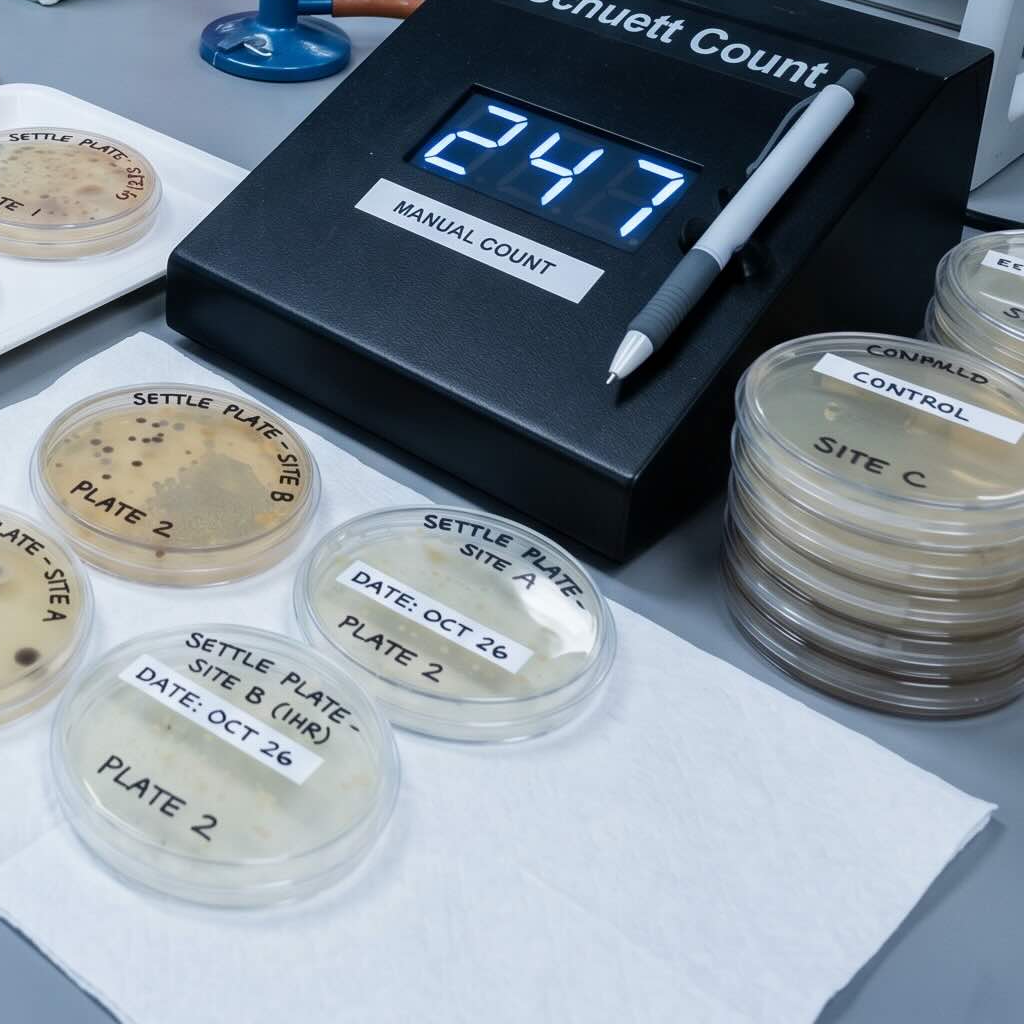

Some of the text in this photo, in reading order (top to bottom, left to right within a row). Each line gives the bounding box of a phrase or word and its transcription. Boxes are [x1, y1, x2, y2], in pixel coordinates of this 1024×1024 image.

[689, 28, 831, 90] Count
[9, 132, 73, 143] SETTLE
[423, 103, 685, 238] 247
[31, 208, 41, 216] 1
[392, 199, 557, 277] MANUAL COUNT
[133, 392, 214, 409] SETTLE
[853, 371, 970, 422] CONTROL
[222, 404, 284, 440] PLATE
[277, 453, 301, 487] SITE
[813, 436, 927, 488] SITE C
[70, 480, 175, 538] PLATE 2
[270, 490, 294, 503] B
[423, 514, 515, 549] SETTLE
[44, 568, 71, 606] SITE
[459, 543, 537, 591] SITE A
[42, 609, 68, 623] A
[350, 570, 509, 661] DATE: OCT 26
[185, 631, 276, 675] SETTLE
[337, 614, 446, 684] PLATE 2
[188, 658, 242, 692] SITE
[244, 685, 266, 705] B
[134, 666, 293, 768] DATE: OCT 26
[97, 754, 218, 842] PLATE 2
